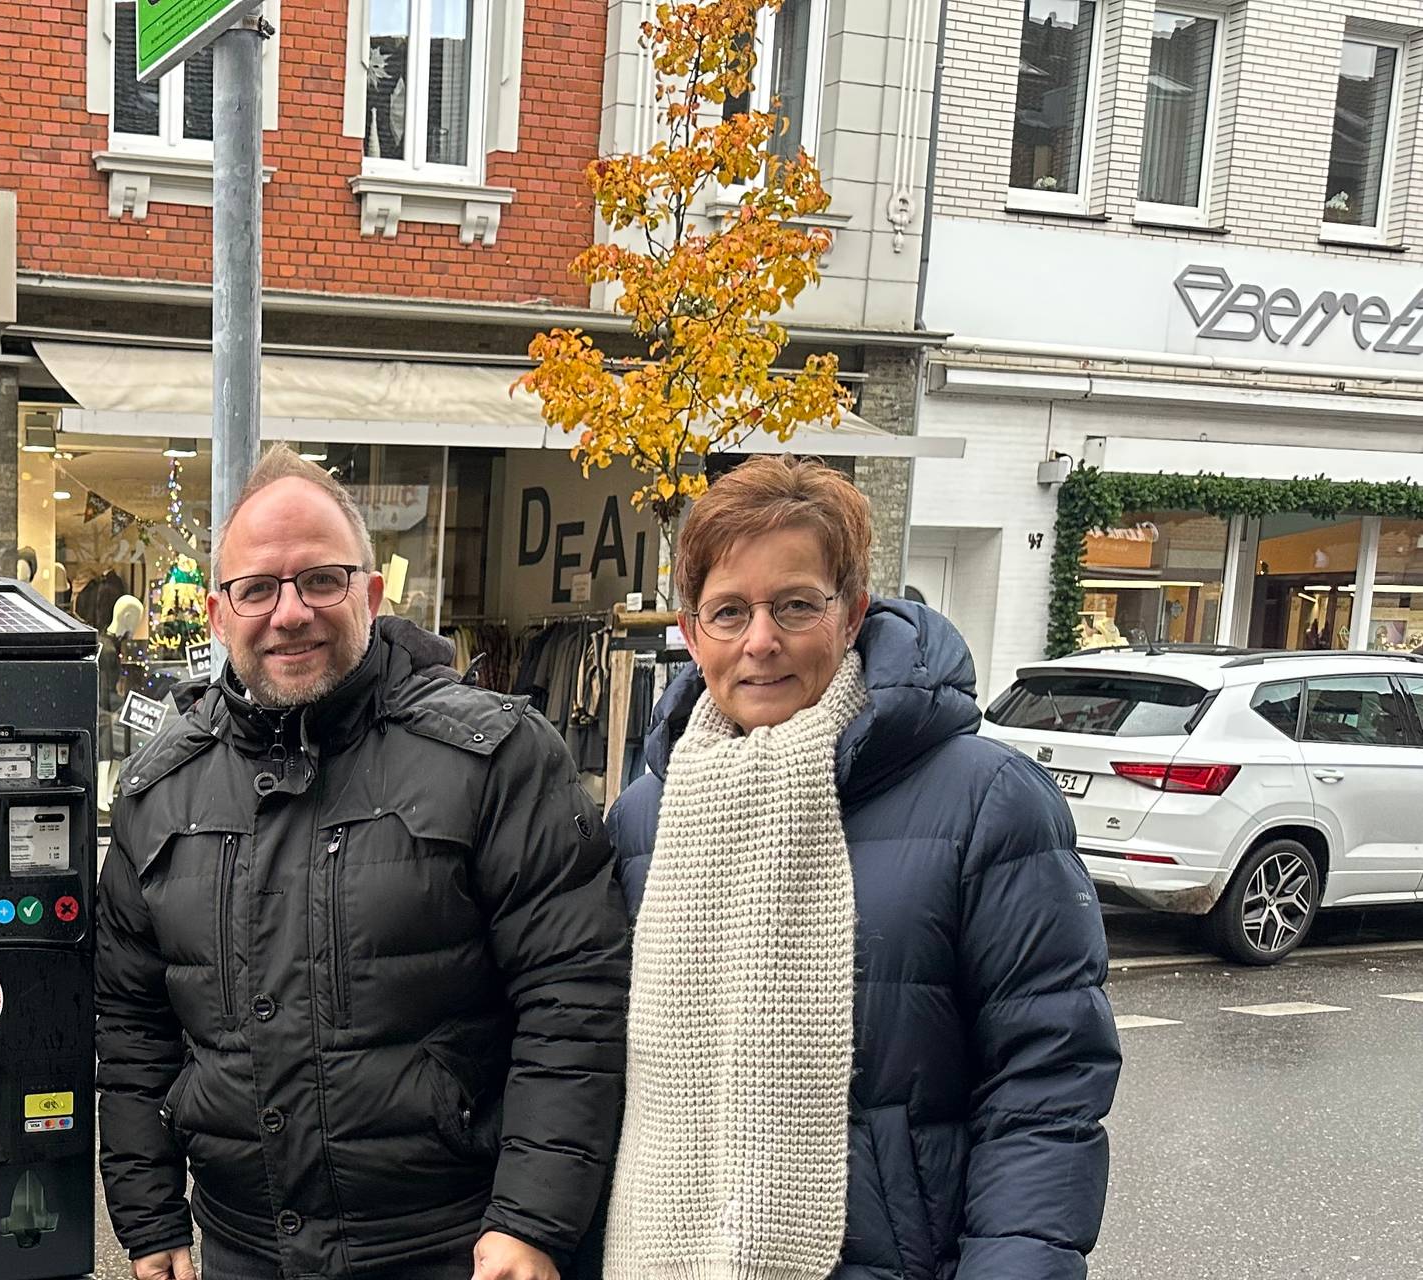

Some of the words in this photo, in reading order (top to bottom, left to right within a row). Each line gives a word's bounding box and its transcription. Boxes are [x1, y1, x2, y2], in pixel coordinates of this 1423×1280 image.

[191, 648, 211, 660] BLA
[130, 698, 163, 720] BLACK
[129, 711, 155, 730] DEAL
